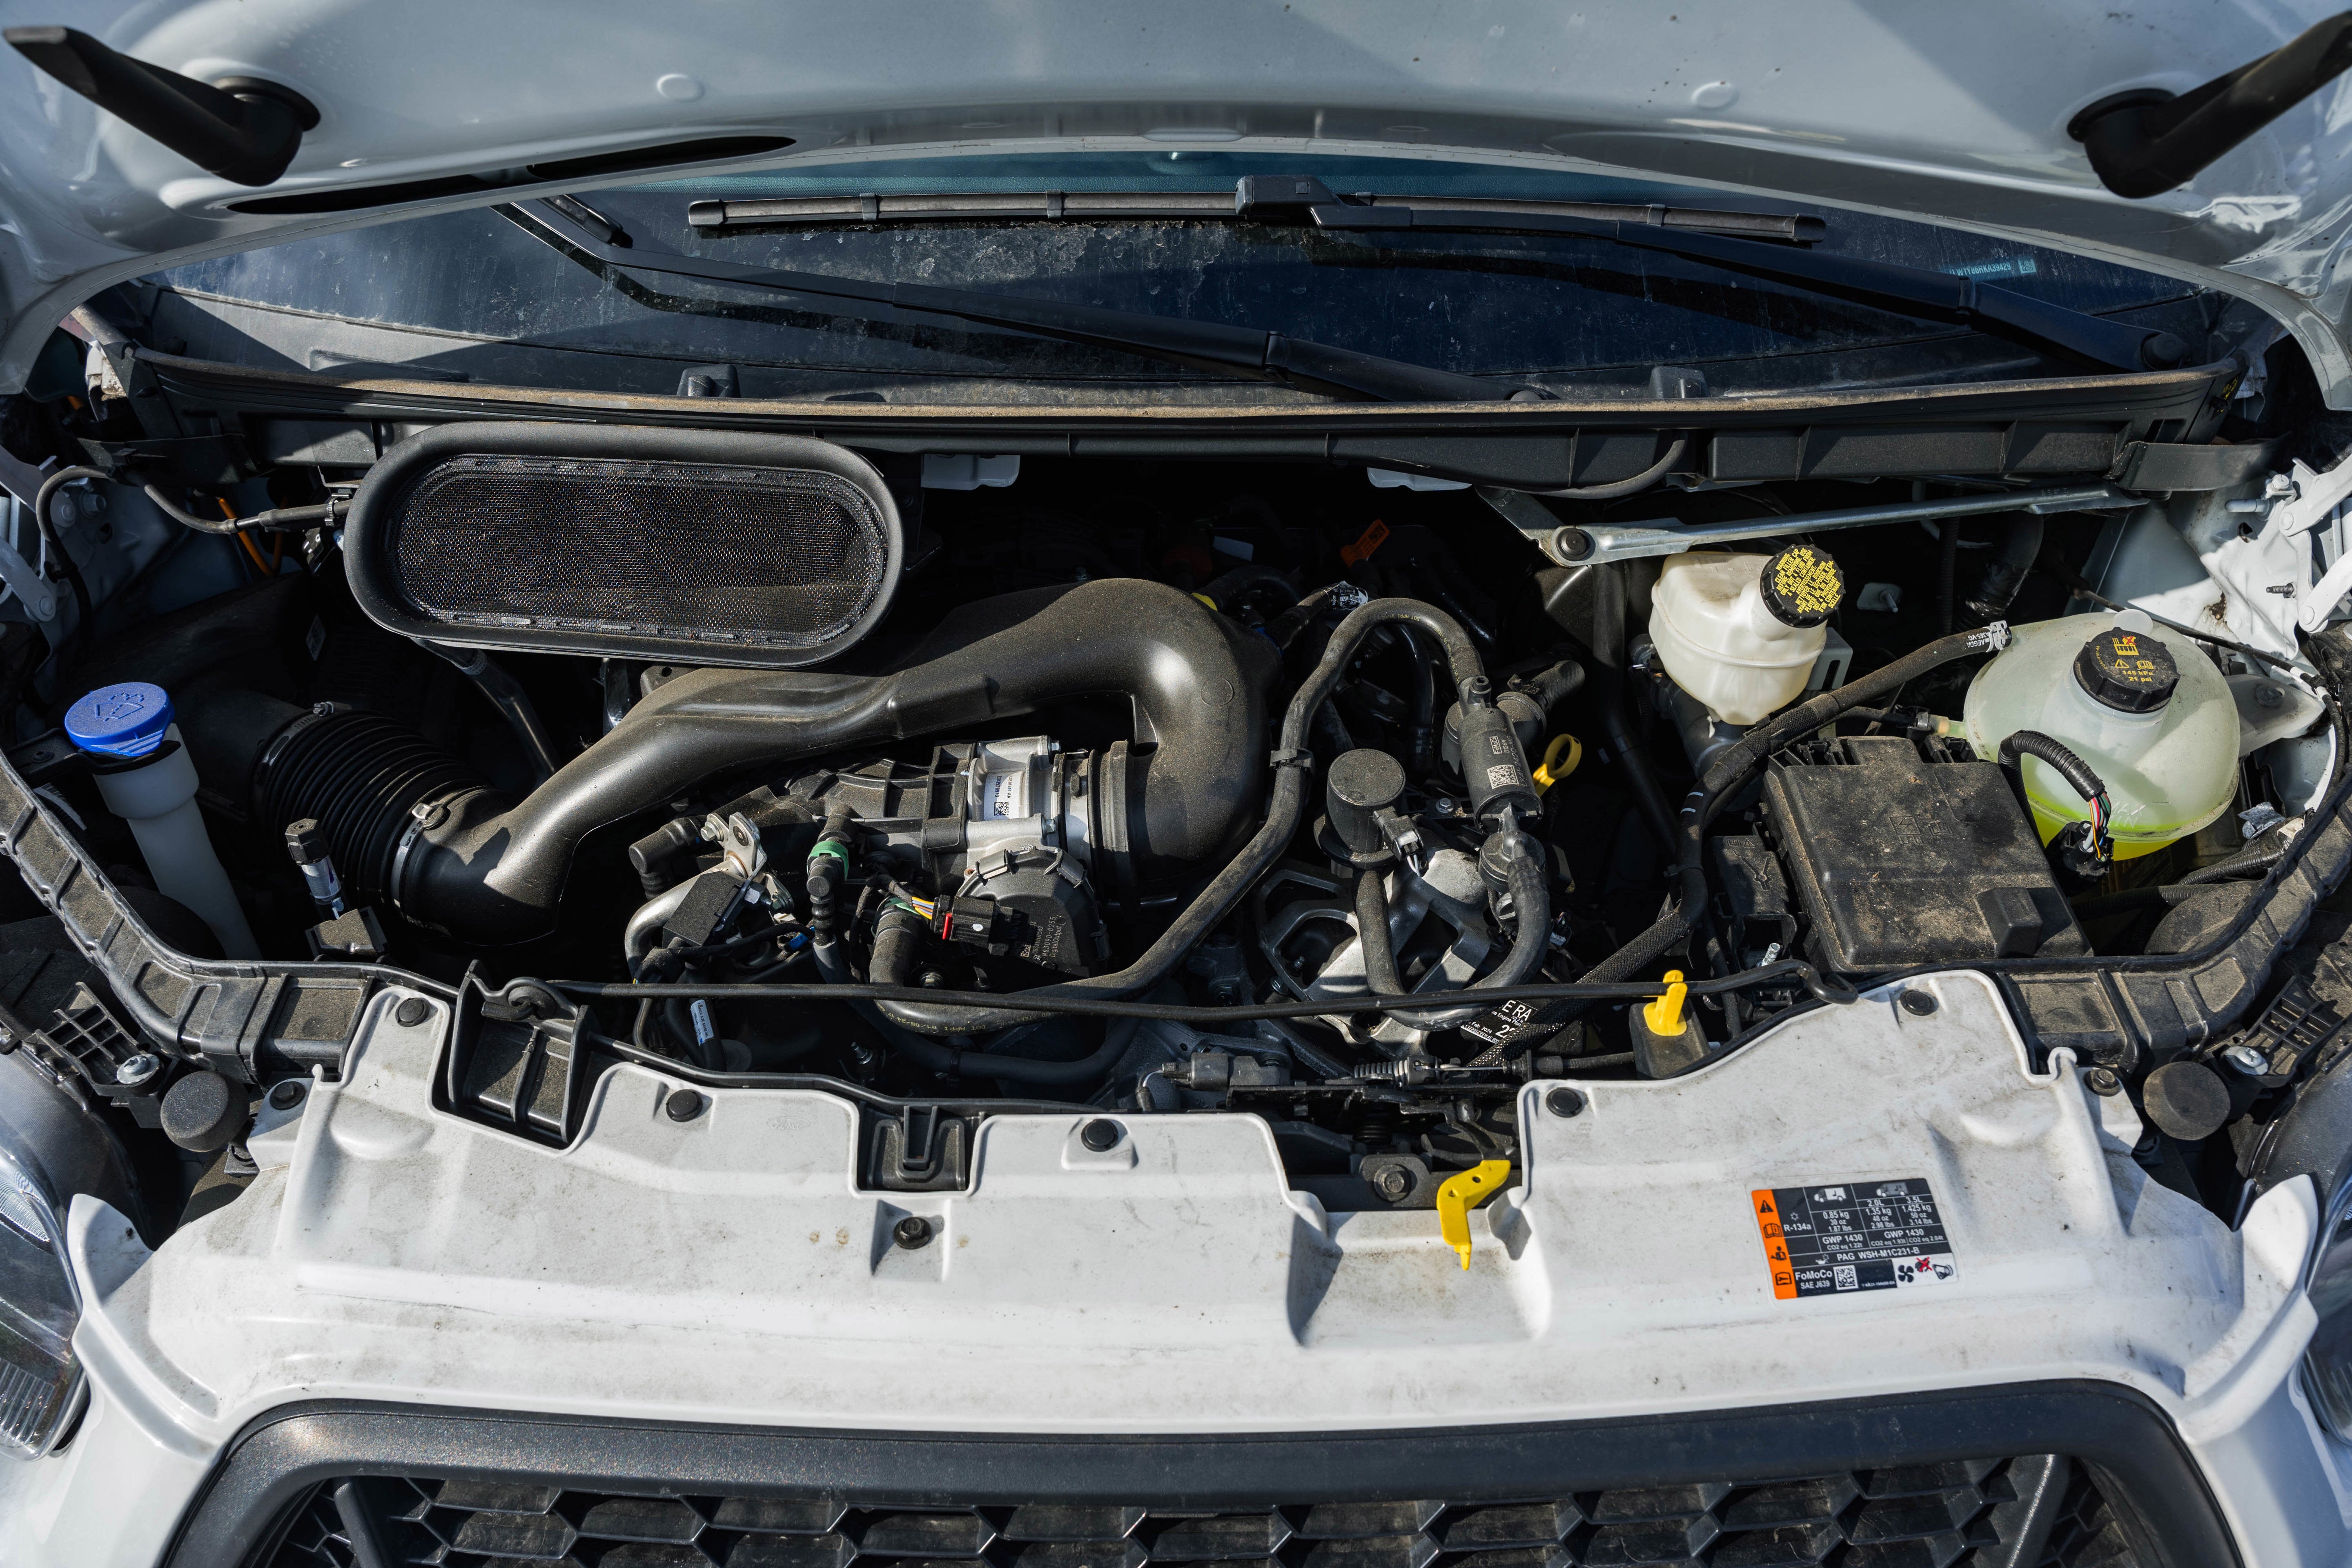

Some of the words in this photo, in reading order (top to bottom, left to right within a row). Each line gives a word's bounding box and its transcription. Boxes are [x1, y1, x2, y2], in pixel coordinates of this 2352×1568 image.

[1775, 570, 1786, 583] CLEAN
[1783, 557, 1794, 571] FILLER
[1776, 577, 1788, 591] BEFORE
[1800, 547, 1808, 556] USE
[1780, 585, 1790, 596] ONLY
[1795, 561, 1805, 573] FLUID
[1803, 550, 1813, 562] FROM
[1790, 577, 1802, 592] SEALED
[1800, 557, 1816, 577] CONTAINER
[1795, 586, 1811, 605] NETTOYER
[1813, 561, 1826, 579] BOUCHON
[1804, 597, 1817, 612] PLOYER
[1824, 568, 1836, 583] LIQUIDE
[1821, 577, 1838, 598] PROVENANT
[1826, 581, 1841, 602] CONTENANT
[1797, 599, 1808, 614] AVANT
[1829, 594, 1841, 608] SCELLE
[1492, 736, 1501, 753] FoMoCo
[1497, 1013, 1511, 1022] Engine
[1840, 1212, 1849, 1220] kg
[1784, 1224, 1811, 1232] R-134a
[1844, 1234, 1863, 1242] 1430
[1837, 1253, 1855, 1261] PAG
[1858, 1248, 1920, 1259] WSH-M1C231-B
[1795, 1270, 1832, 1281] FoMoCo
